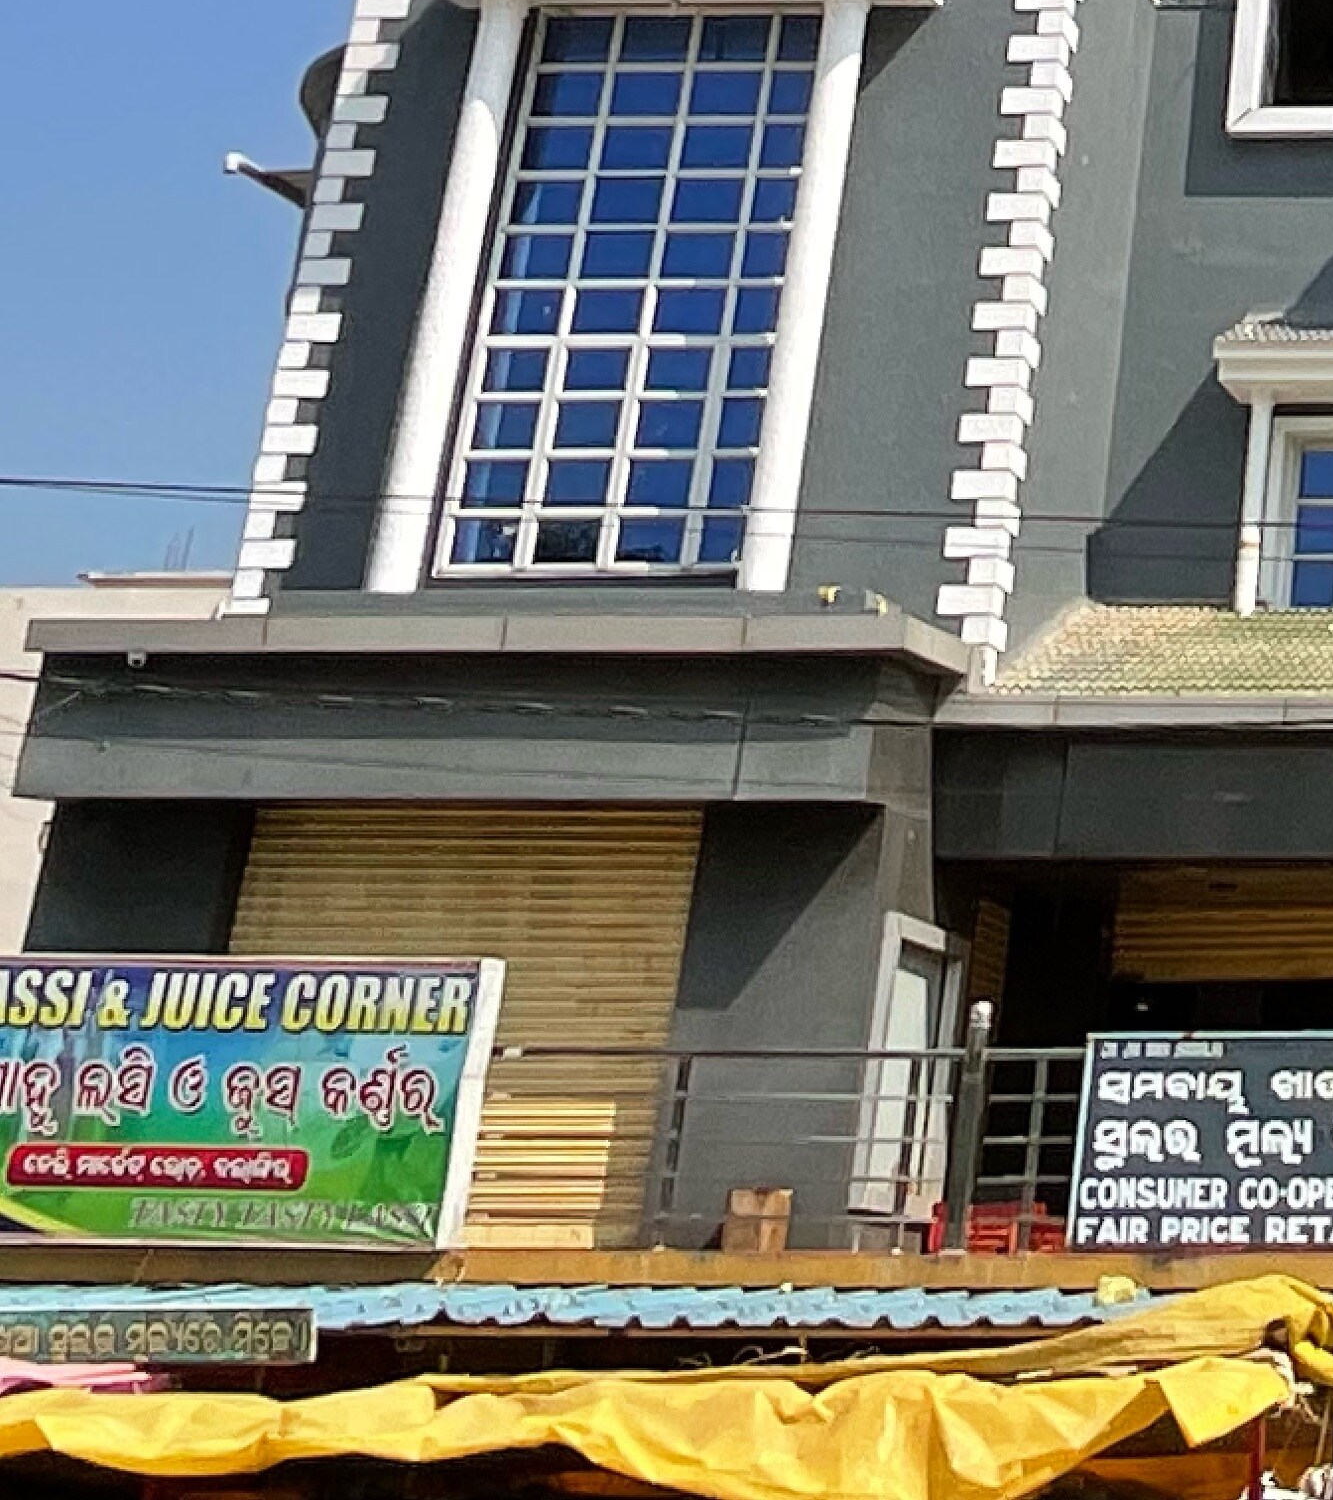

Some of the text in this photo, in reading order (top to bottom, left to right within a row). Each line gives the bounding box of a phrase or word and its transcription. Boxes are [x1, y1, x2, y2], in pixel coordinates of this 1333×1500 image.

[0, 967, 474, 1034] SSI & JUICE CORNER
[169, 1054, 209, 1114] ଓ
[1080, 1178, 1228, 1209] CONSUMER
[1077, 1217, 1149, 1244] FAIR
[1160, 1216, 1251, 1244] PRICE
